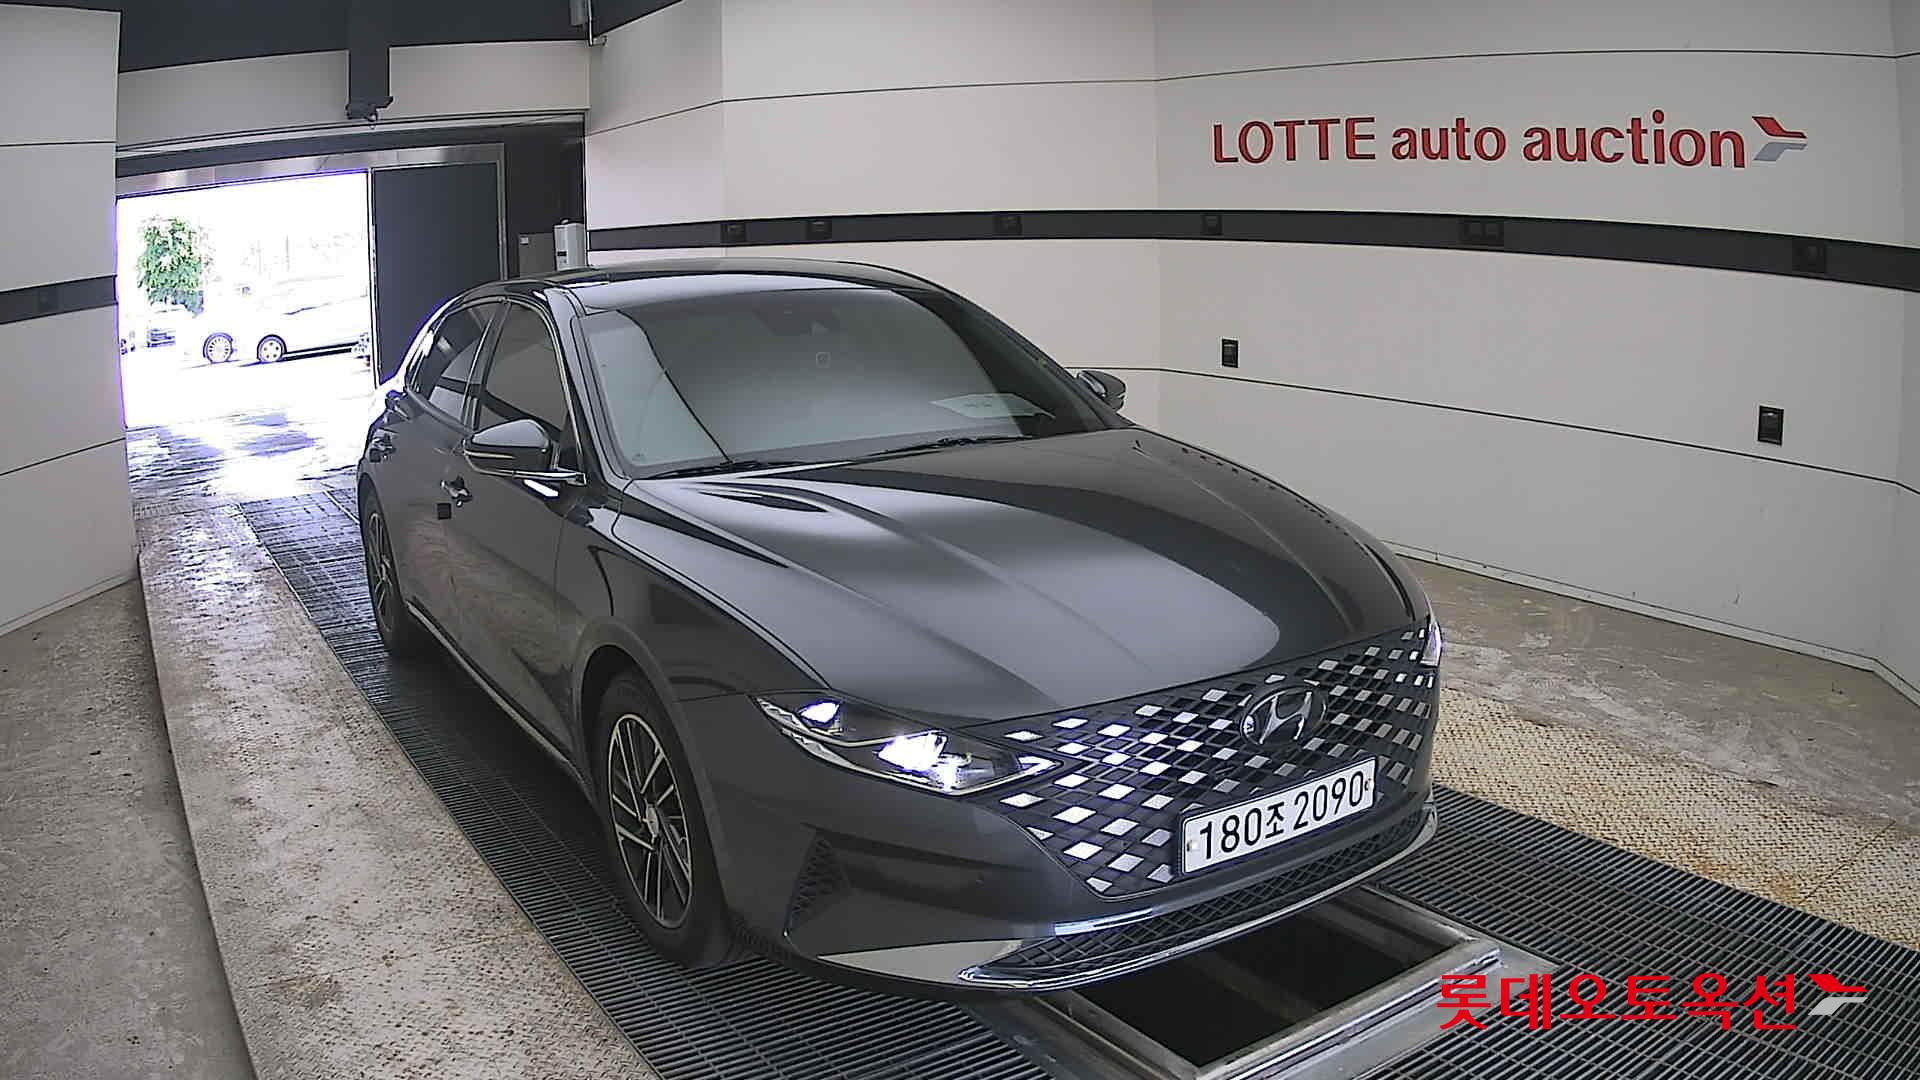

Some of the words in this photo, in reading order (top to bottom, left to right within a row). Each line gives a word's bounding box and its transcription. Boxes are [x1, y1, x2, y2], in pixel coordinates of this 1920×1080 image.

[1212, 116, 1376, 163] LOTTE
[1391, 117, 1506, 161] auto
[1523, 110, 1746, 168] auction
[1199, 801, 1285, 860] 180조
[1293, 770, 1364, 831] 2090
